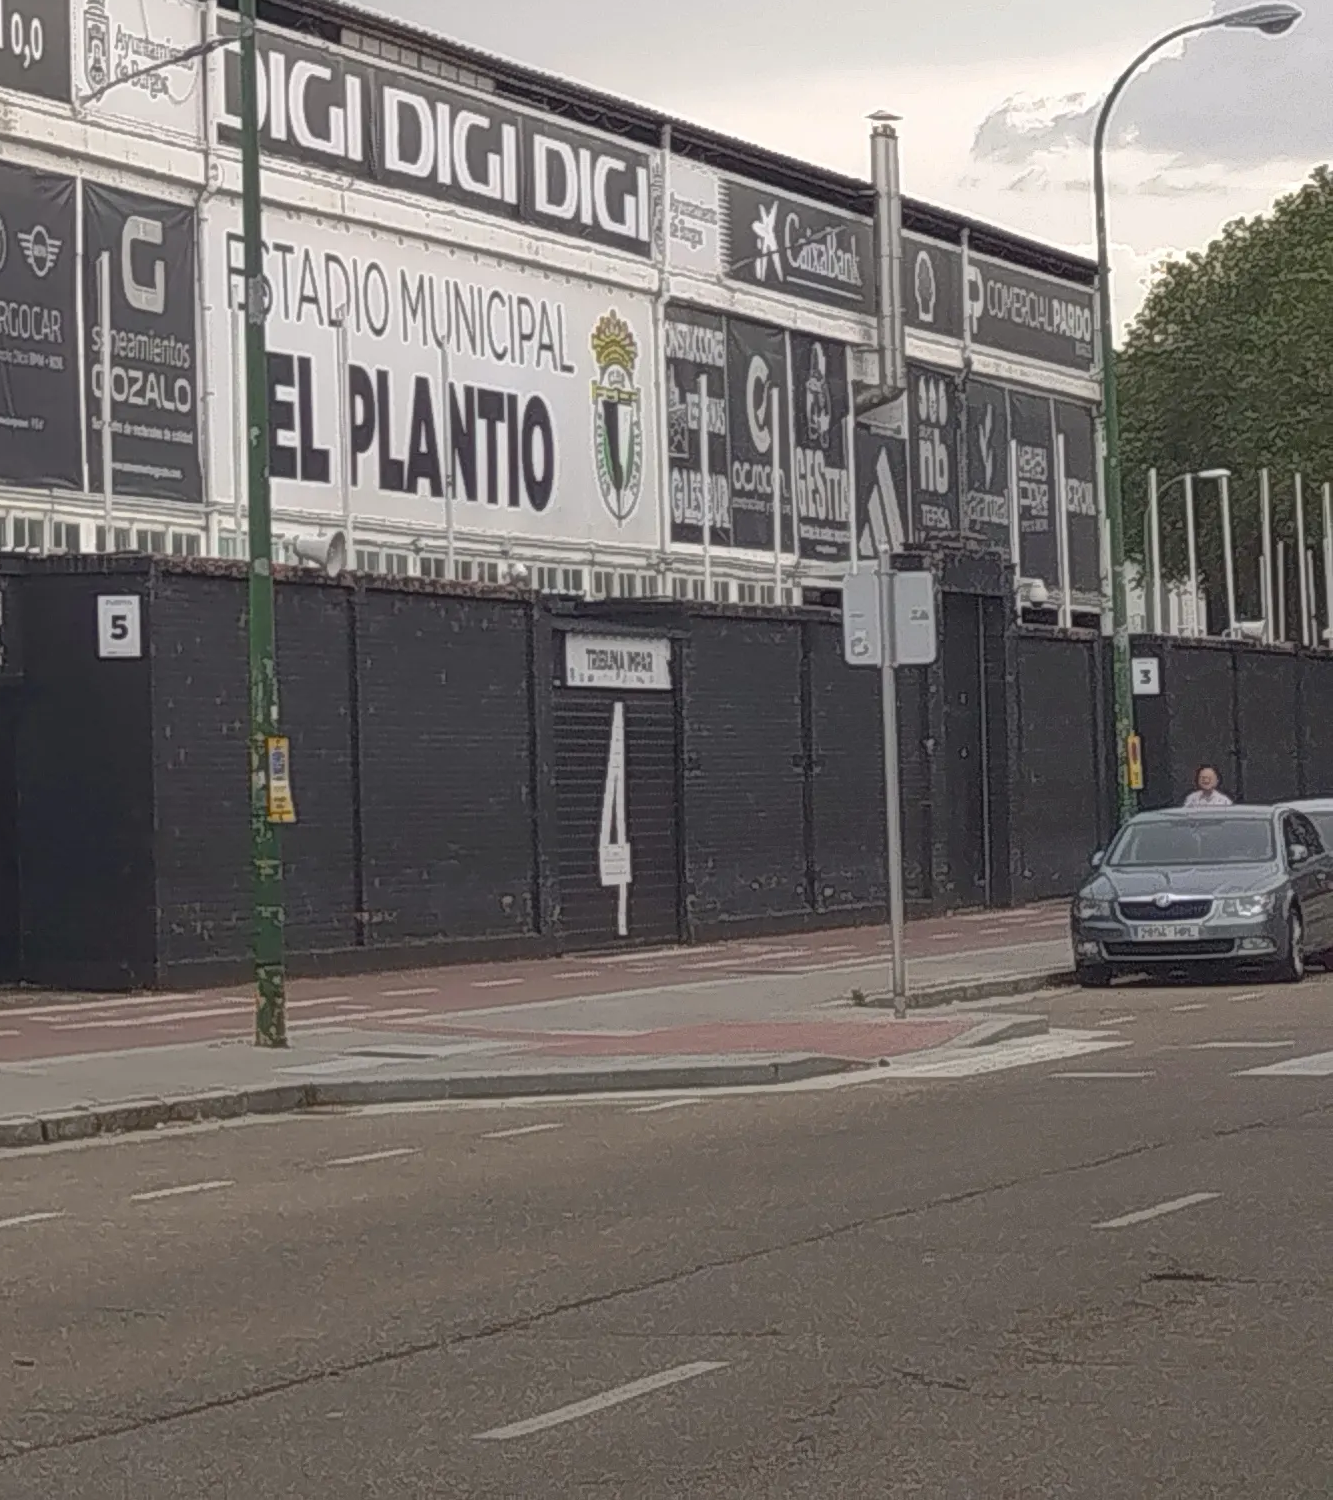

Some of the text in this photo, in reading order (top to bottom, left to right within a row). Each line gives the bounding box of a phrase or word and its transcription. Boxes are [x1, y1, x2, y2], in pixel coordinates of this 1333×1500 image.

[215, 41, 649, 242] DIGI DIGI DIGI
[400, 267, 575, 375] MUNICIPAL
[266, 351, 557, 513] EL PLANTIO
[110, 614, 129, 640] 5
[1139, 669, 1152, 685] 3
